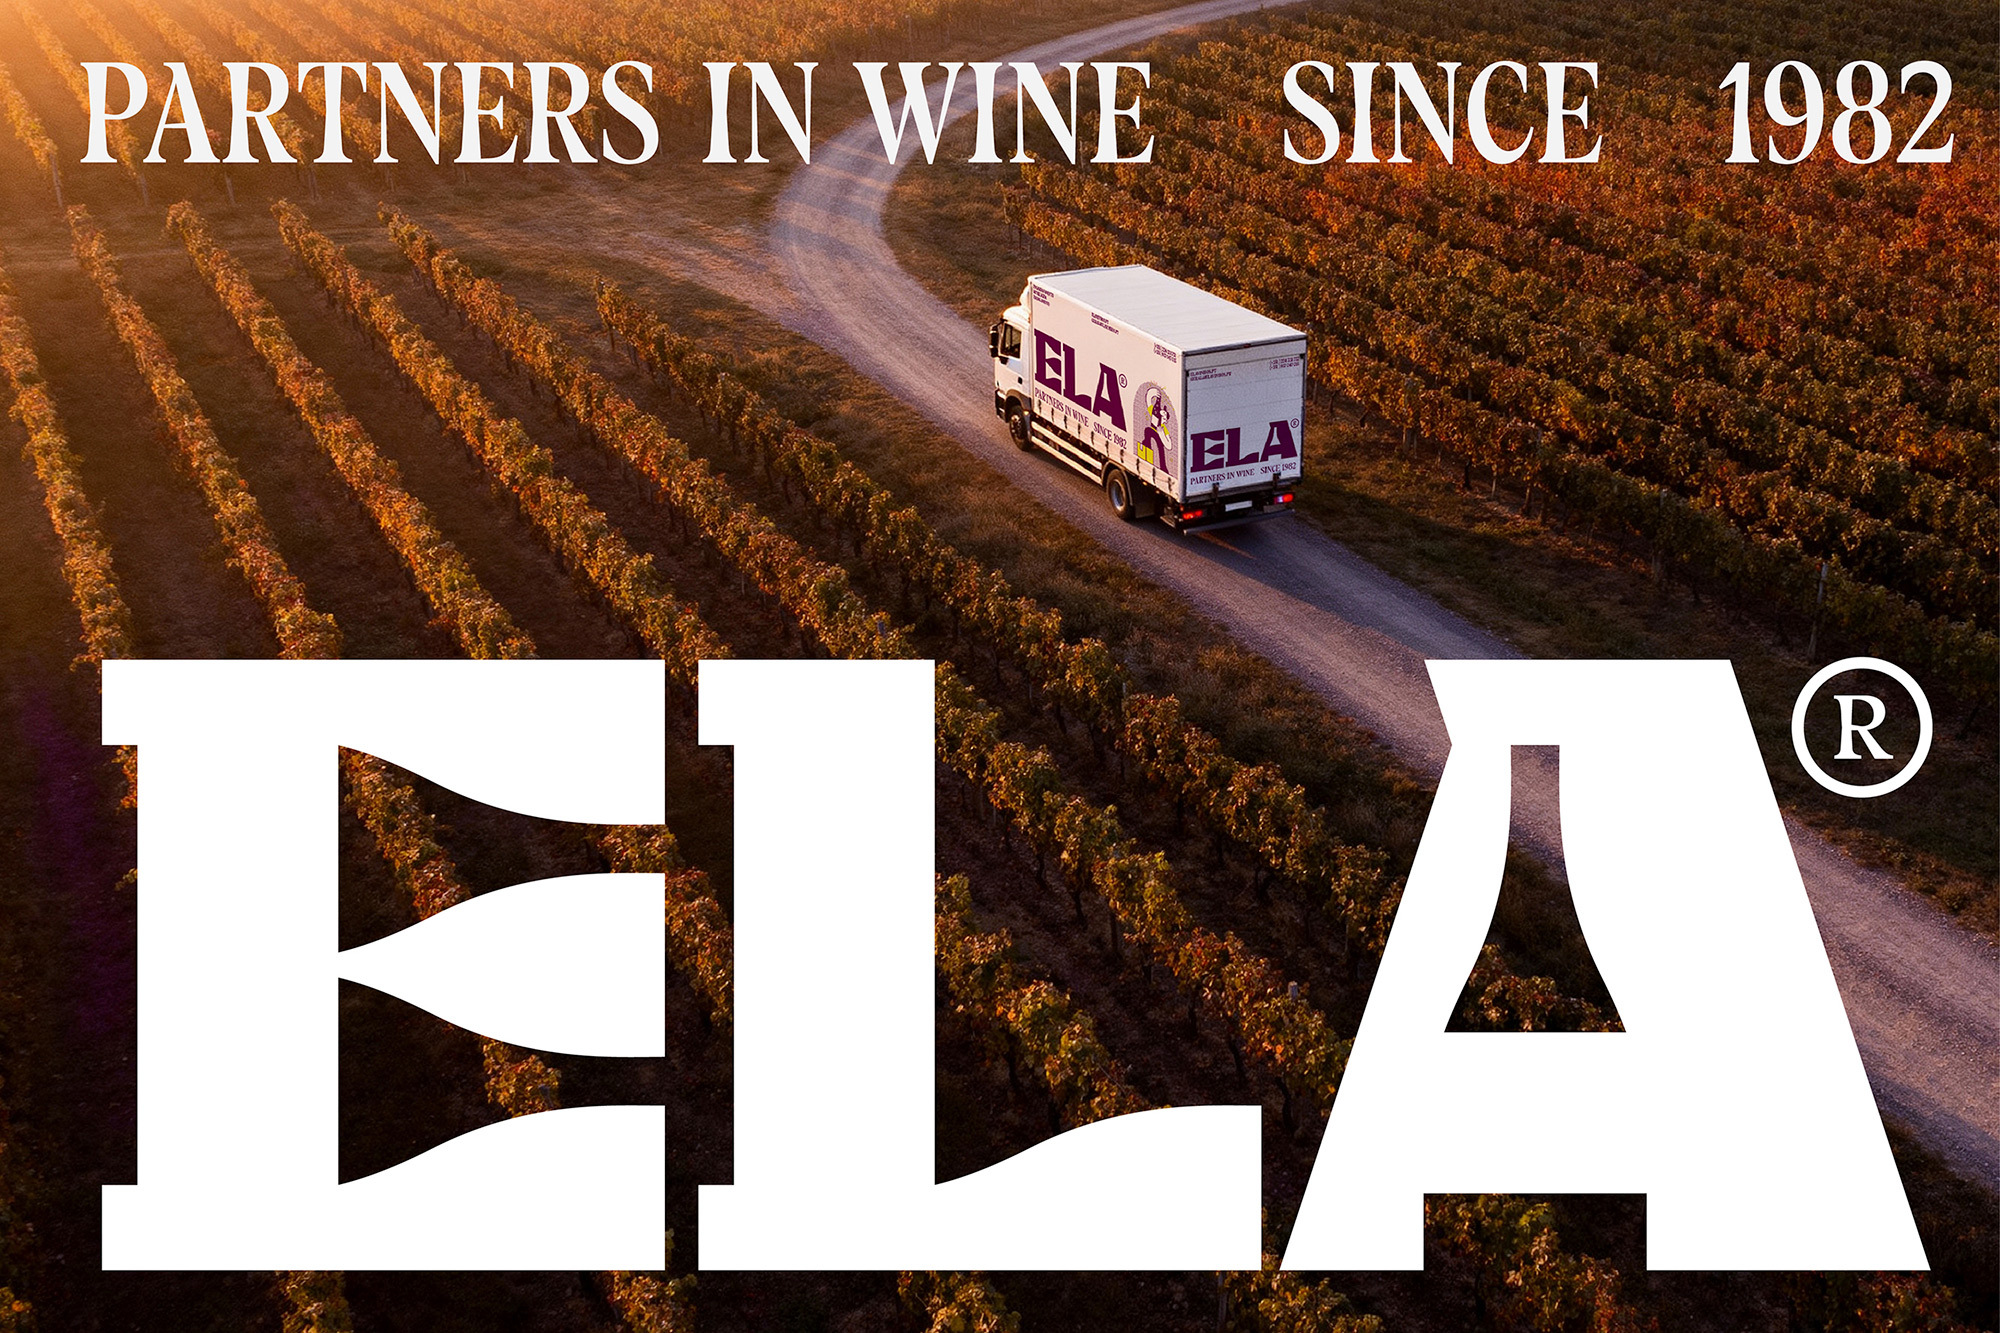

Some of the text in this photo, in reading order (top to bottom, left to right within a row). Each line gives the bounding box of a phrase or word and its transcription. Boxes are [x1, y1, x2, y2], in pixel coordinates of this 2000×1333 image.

[1035, 387, 1127, 449] PARTNERS IN WINE SINCE 1982
[1190, 461, 1297, 486] PARTNERS IN WINE SINCE 1982
